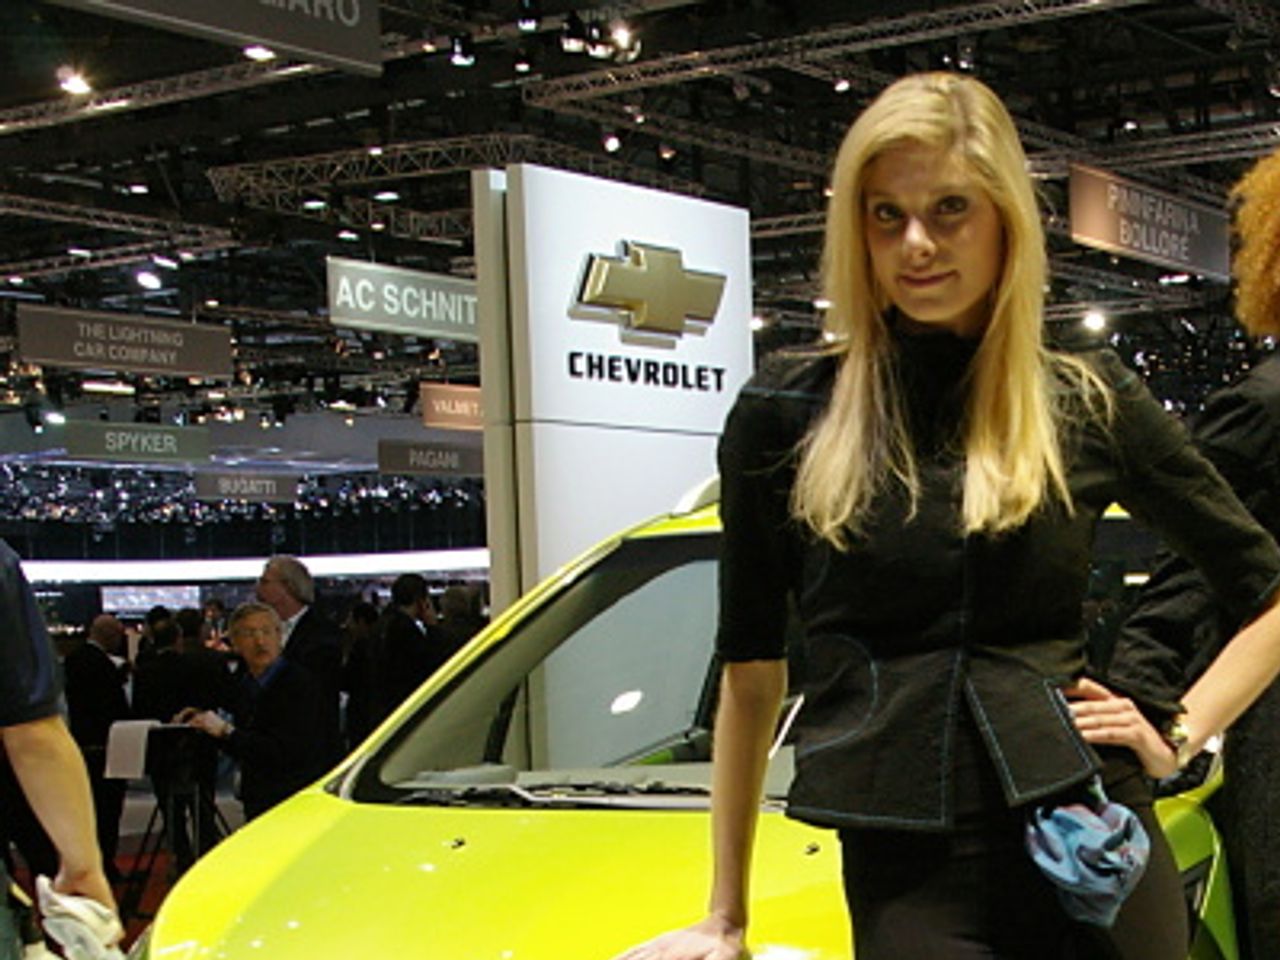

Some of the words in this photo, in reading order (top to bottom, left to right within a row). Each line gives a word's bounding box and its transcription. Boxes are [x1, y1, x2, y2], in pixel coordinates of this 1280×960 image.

[335, 274, 377, 312] AC
[77, 322, 107, 342] THE
[108, 324, 185, 347] LIGHTNING
[73, 341, 107, 358] CAR
[108, 345, 179, 364] COMPANY
[567, 351, 728, 393] CHEVROLET
[104, 431, 178, 454] SPYKER
[216, 477, 278, 495] BUGATTI
